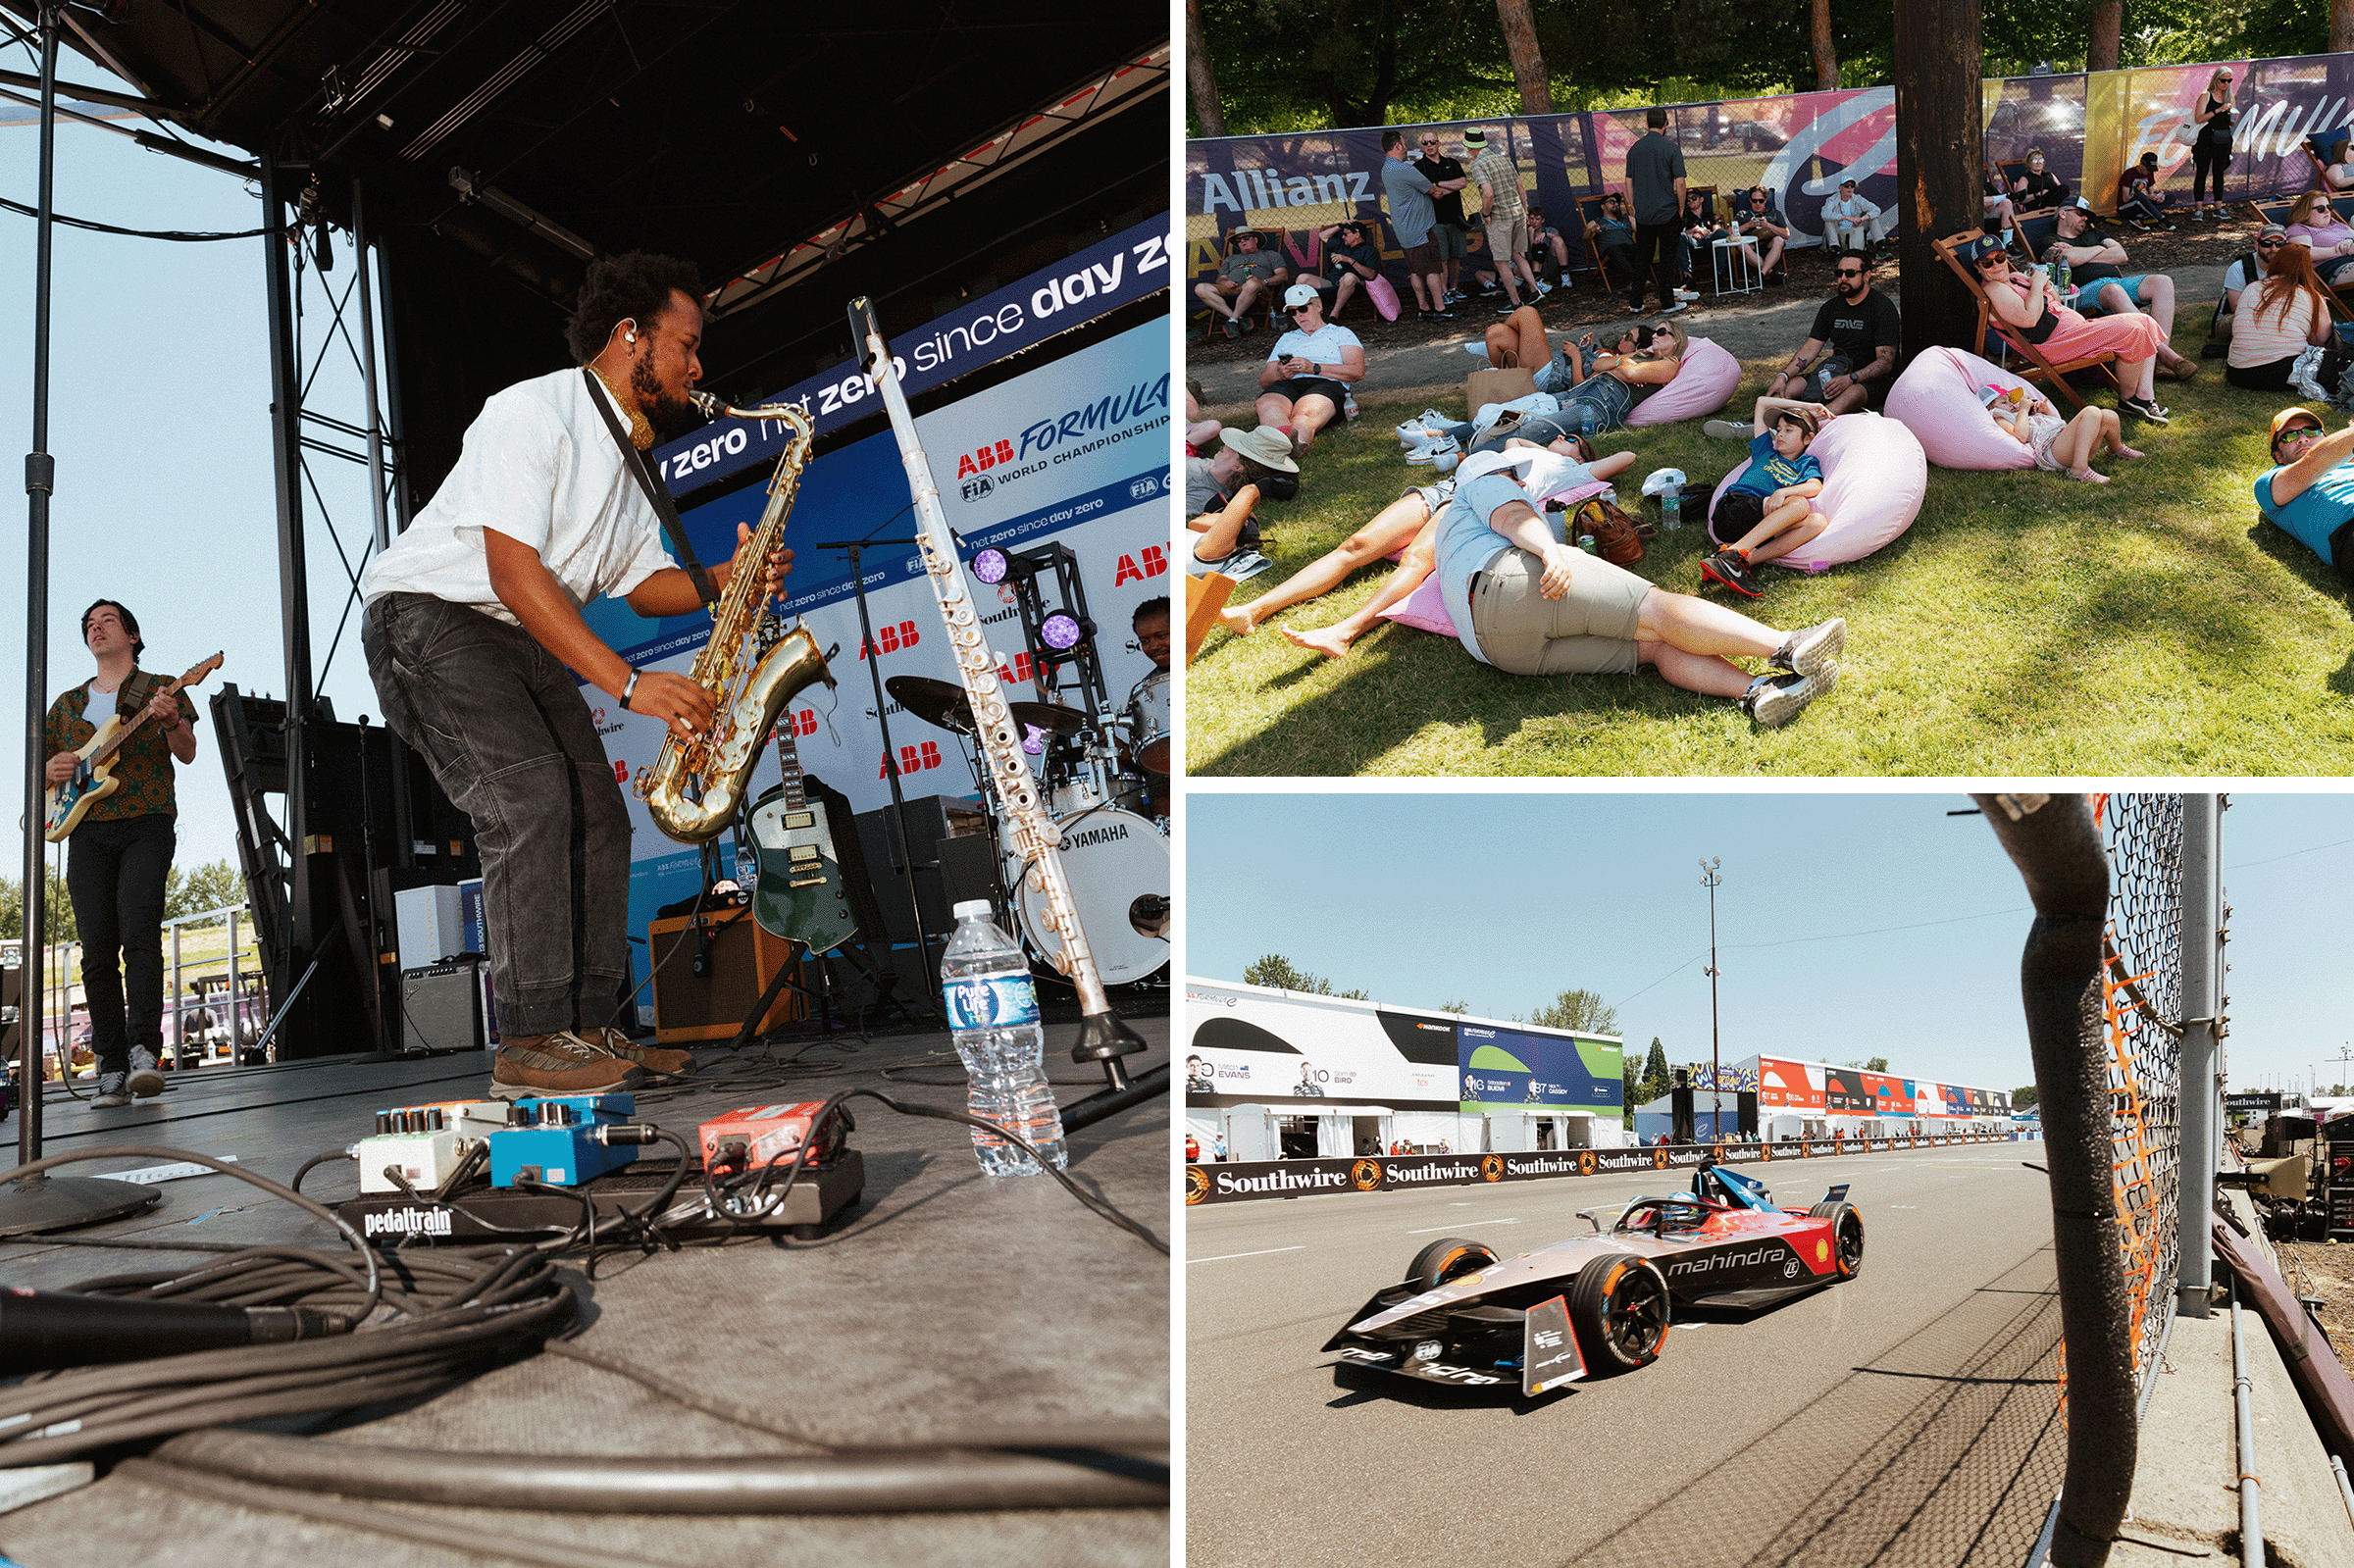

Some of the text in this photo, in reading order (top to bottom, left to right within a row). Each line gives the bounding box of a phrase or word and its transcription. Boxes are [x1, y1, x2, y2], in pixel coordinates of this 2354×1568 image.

[1201, 169, 1375, 215] Allianz
[673, 428, 747, 480] zero
[914, 303, 1024, 373] since
[1031, 251, 1125, 320] day
[957, 372, 1170, 480] ABB FORMULA
[998, 460, 1048, 484] WORLD
[1052, 414, 1170, 466] CHAMPIONSHIP
[971, 498, 1104, 550] net zero since day zero
[1114, 541, 1170, 587] AB
[779, 599, 794, 612] net
[794, 593, 816, 608] zero
[816, 584, 841, 600] since
[862, 571, 886, 586] zero
[636, 648, 654, 660] zero
[654, 640, 675, 655] since
[675, 634, 691, 648] day
[691, 629, 711, 642] zero
[859, 620, 920, 661] ABB
[597, 722, 625, 736] hwire
[1071, 824, 1129, 849] YAMAHA
[473, 893, 485, 943] SOUTHWIRE
[957, 985, 991, 999] Pure
[962, 996, 989, 1015] Life
[1218, 1070, 1251, 1080] EVANS
[1312, 1069, 1329, 1083] 10
[1473, 1079, 1485, 1090] 16
[1725, 1147, 1761, 1160] Southwire
[1771, 1145, 1801, 1157] Southwire
[1810, 1143, 1835, 1156] Southwire
[1842, 1141, 1864, 1151] Southwire
[1386, 1160, 1478, 1184] Southwire
[1508, 1154, 1577, 1176] Southwire
[1598, 1151, 1653, 1170] Southwire
[1217, 1167, 1347, 1194] Southwire
[365, 1206, 451, 1238] pedaltrain
[1667, 1247, 1785, 1277] mahindra
[1785, 1261, 1798, 1275] ZF
